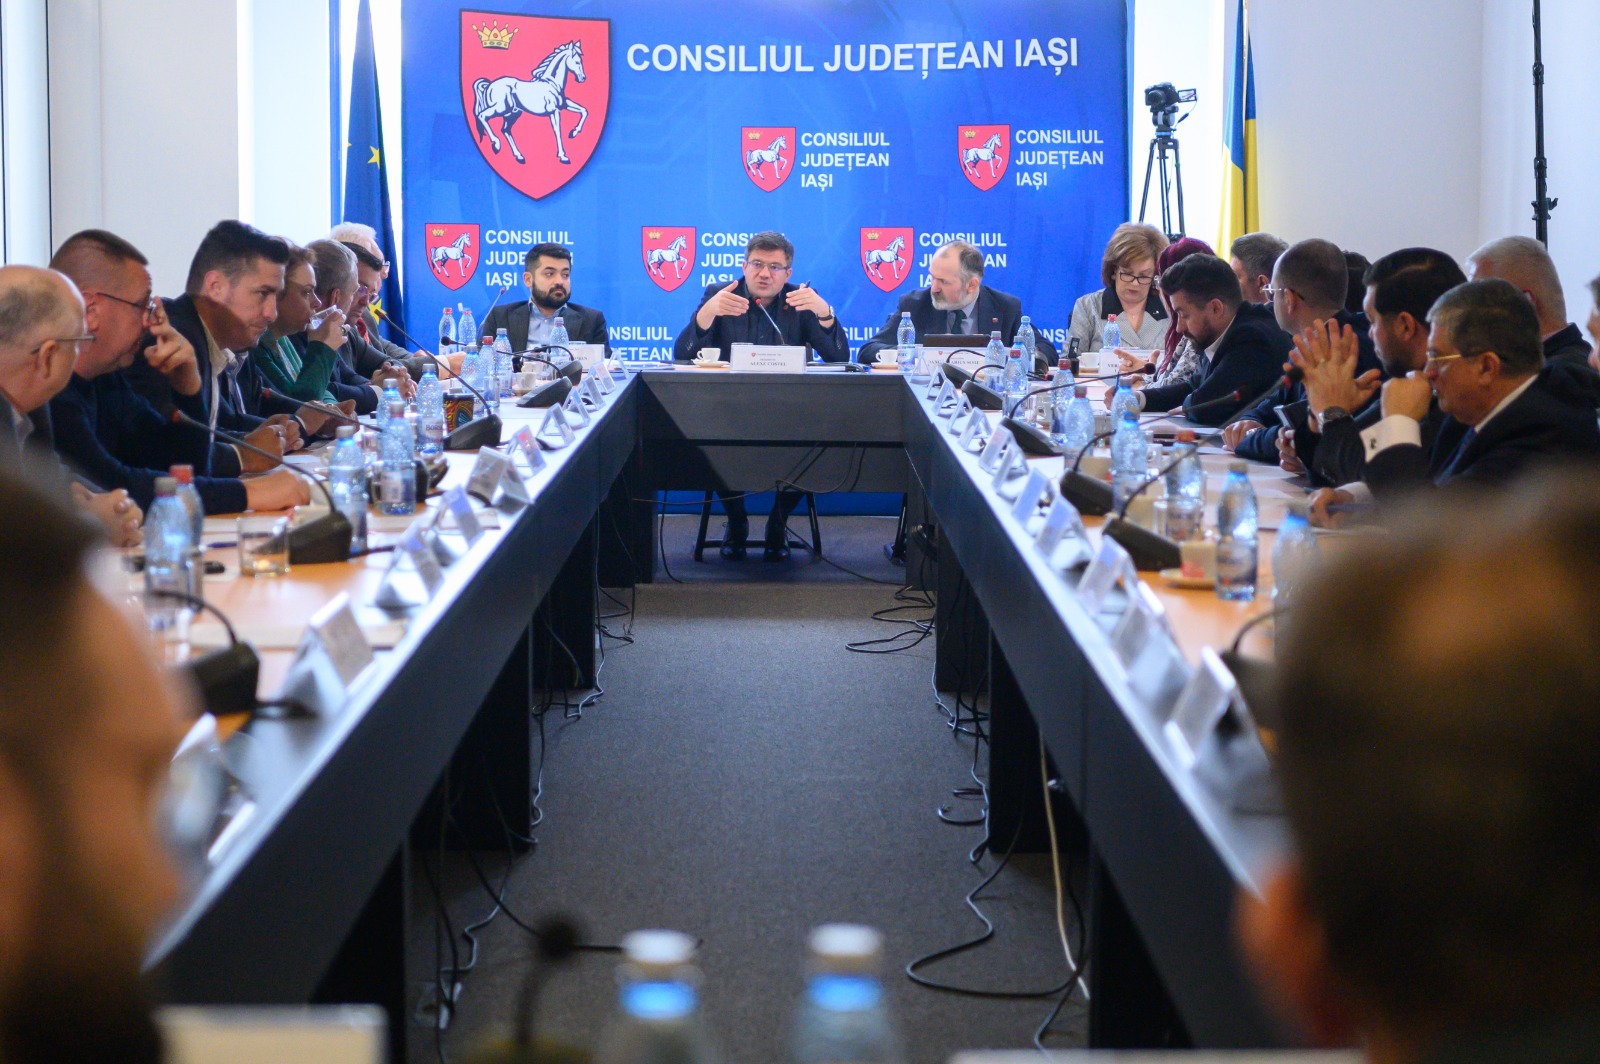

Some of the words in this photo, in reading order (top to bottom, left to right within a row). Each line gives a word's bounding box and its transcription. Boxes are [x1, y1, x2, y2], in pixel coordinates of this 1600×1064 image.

[626, 43, 815, 72] CONSILIUL
[823, 40, 1004, 80] JUDEȚEAN
[1015, 37, 1078, 76] IAȘI
[801, 132, 890, 147] CONSILIUL
[1015, 129, 1104, 144] CONSILIUL
[800, 152, 890, 172] JUDEȚEAN
[1015, 150, 1104, 170] JUDEȚEAN
[801, 173, 833, 192] IAȘI
[1016, 171, 1048, 191] IAȘI
[485, 229, 574, 245] CONSILIUL
[485, 272, 518, 290] IAȘI
[607, 326, 673, 341] NSILIUL
